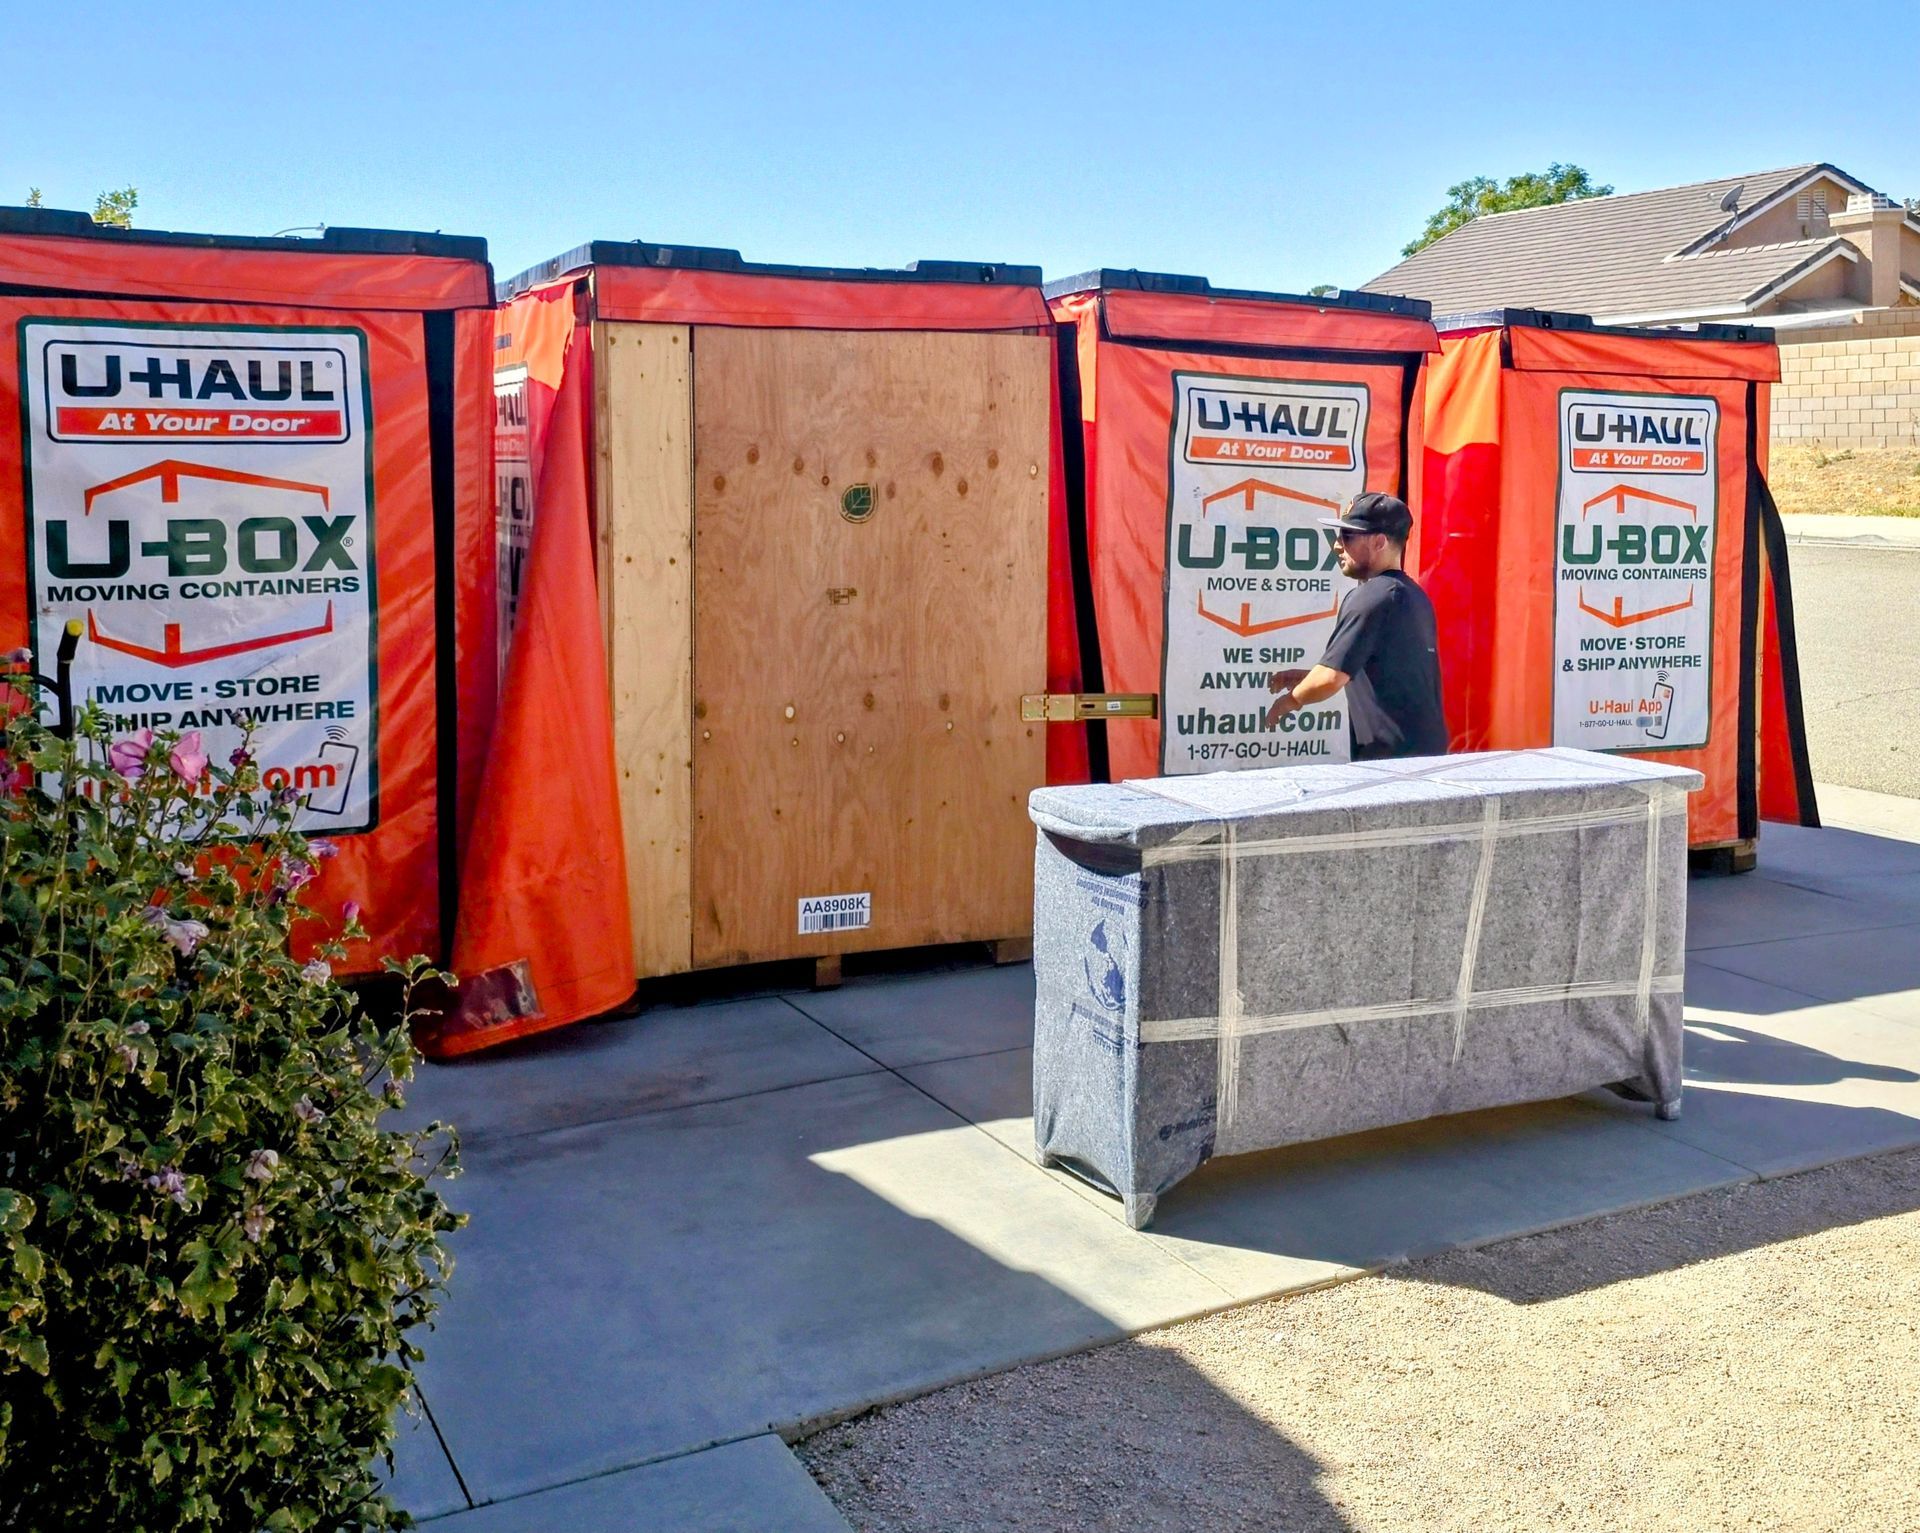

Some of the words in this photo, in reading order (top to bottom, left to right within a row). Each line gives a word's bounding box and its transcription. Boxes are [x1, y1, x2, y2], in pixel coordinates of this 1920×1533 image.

[61, 354, 335, 401] U-HAUL
[98, 413, 136, 431] At
[146, 413, 219, 432] Your
[228, 414, 305, 432] Door
[1197, 397, 1348, 439] U-HAUL
[1575, 413, 1702, 446] U-HAUL
[1216, 442, 1240, 456] At
[1244, 443, 1285, 458] Your
[1289, 445, 1333, 460] Door
[1589, 453, 1608, 464] At
[1613, 453, 1648, 466] Your
[1651, 454, 1687, 466] Door
[46, 515, 358, 580] U-BOX
[1563, 524, 1709, 565] U-BOX
[1561, 569, 1618, 580] MOVING
[1622, 568, 1707, 580] CONTAINERS
[48, 583, 169, 602] MOVING
[180, 576, 360, 599] CONTAINERS
[1207, 577, 1257, 591] MOVE
[1261, 578, 1272, 591] &
[1275, 578, 1331, 591] STORE
[1580, 638, 1627, 651] MOVE
[1635, 636, 1686, 650] STORE
[1223, 648, 1253, 663] WE
[1258, 647, 1305, 663] SHIP
[1562, 659, 1574, 672] &
[1577, 657, 1616, 672] SHIP
[1618, 655, 1702, 670] ANYWHERE
[97, 682, 193, 703] MOVE
[215, 675, 320, 699] STORE
[178, 700, 355, 729] ANYWHERE
[1589, 699, 1634, 714] U-Haul
[1638, 698, 1663, 715] App
[1187, 739, 1331, 760] 1-877-GO-U-HAUL
[803, 897, 866, 914] AA8908K
